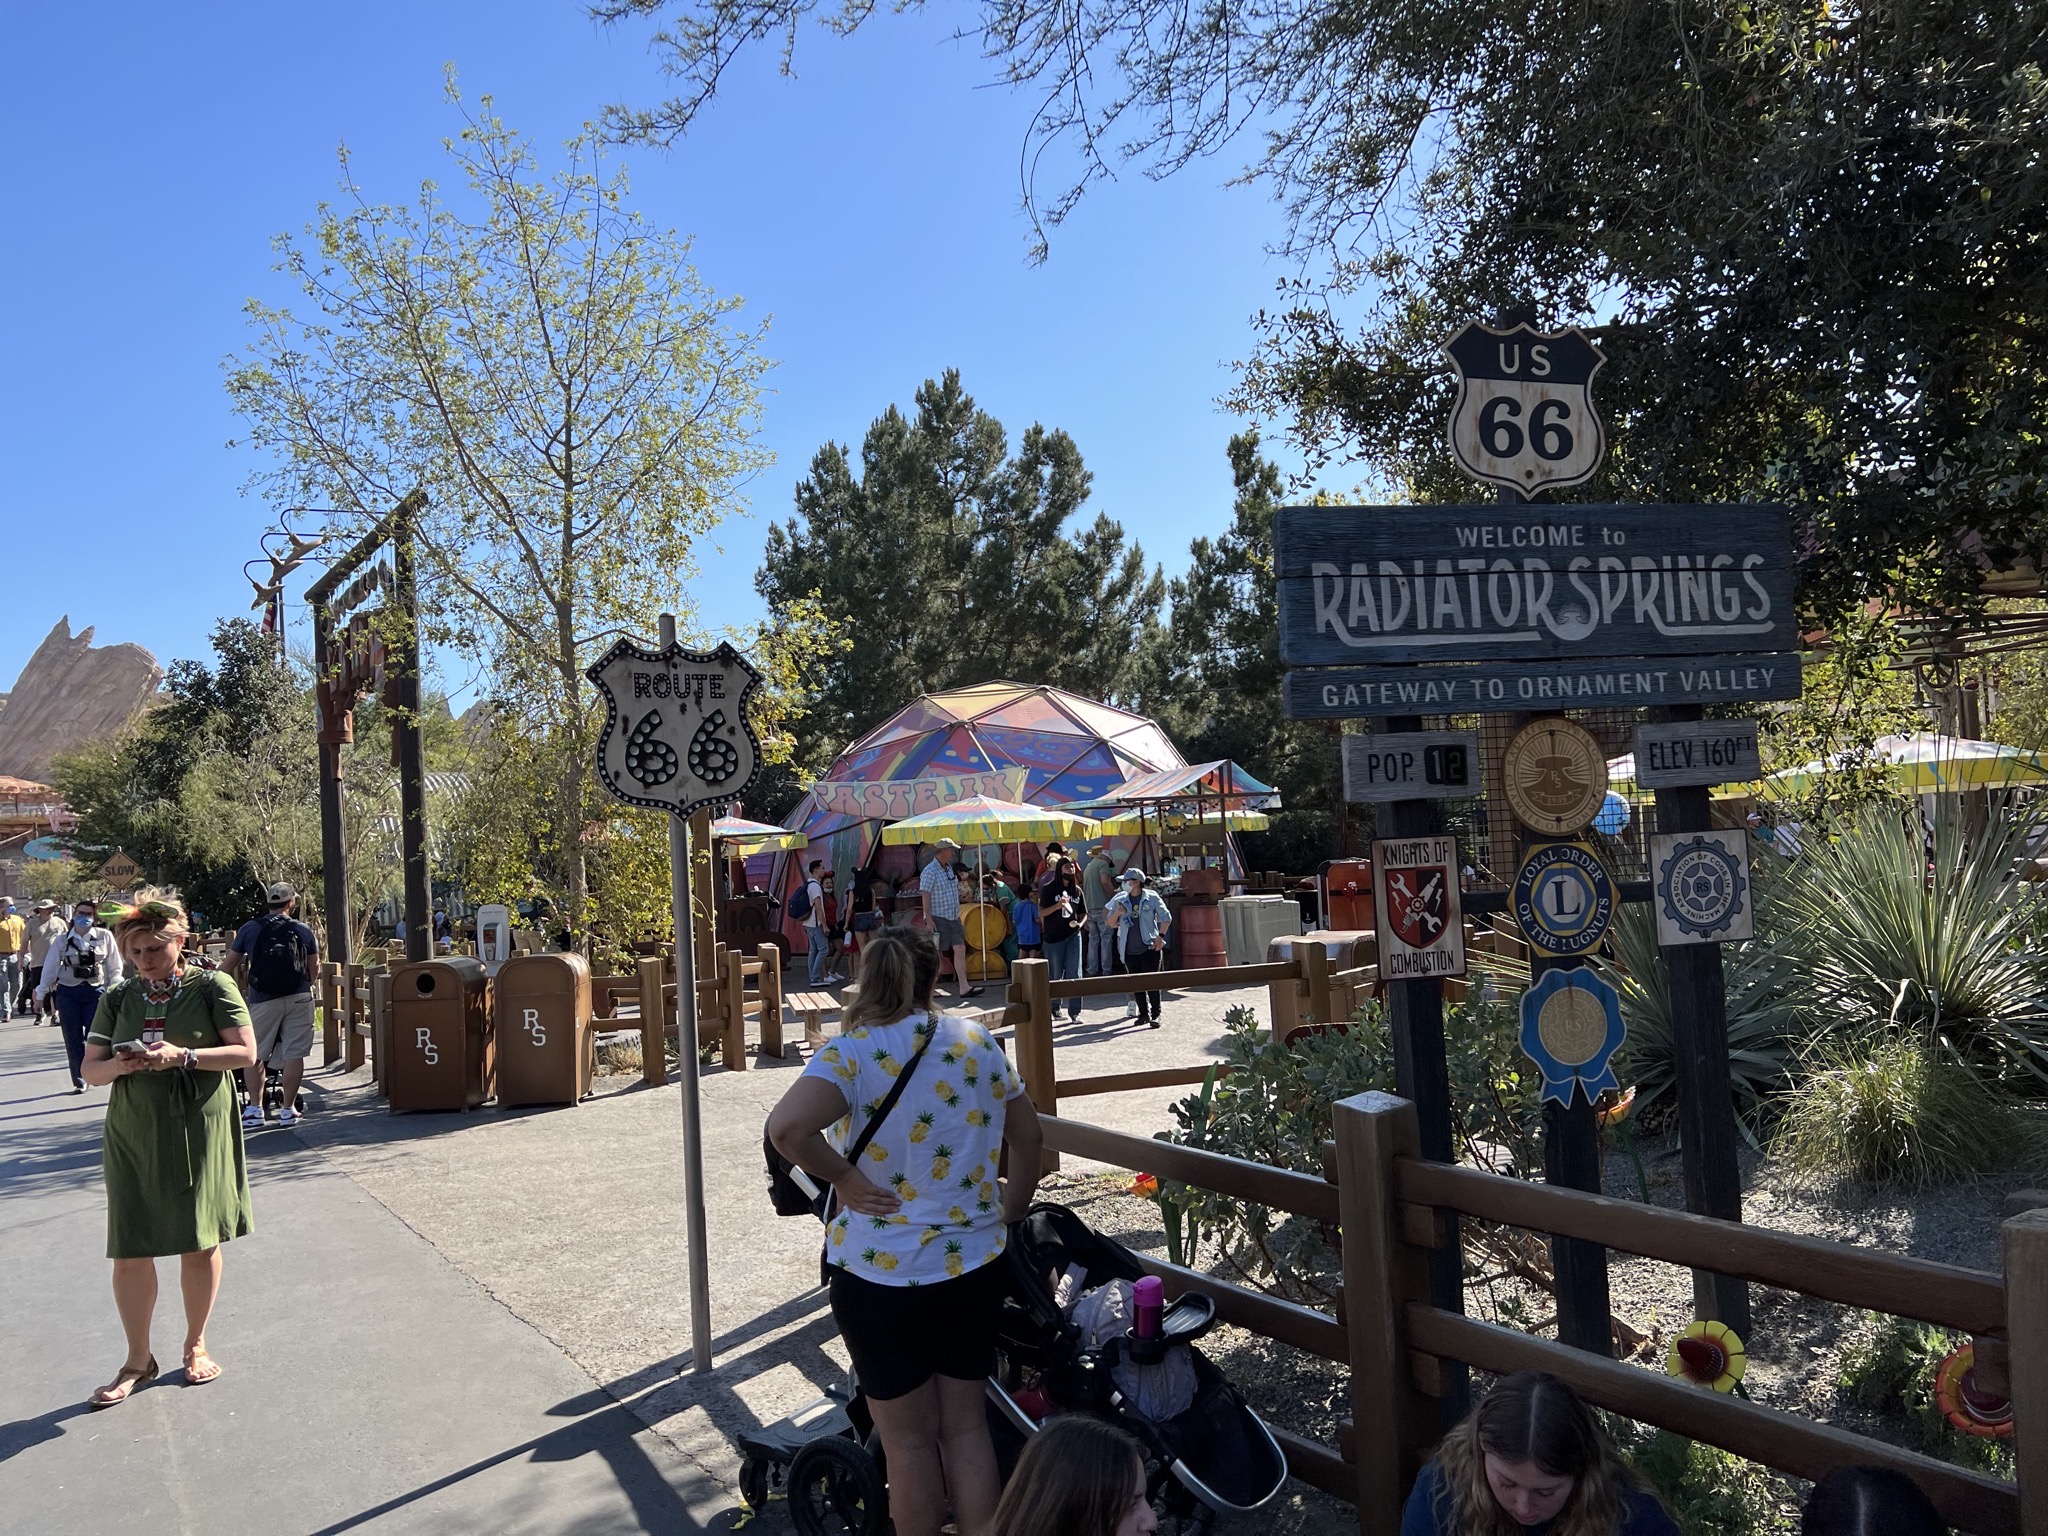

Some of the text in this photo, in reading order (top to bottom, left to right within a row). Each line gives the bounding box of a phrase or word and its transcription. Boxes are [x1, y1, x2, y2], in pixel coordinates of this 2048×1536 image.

[1499, 343, 1551, 376] US
[1478, 395, 1574, 461] 66
[1455, 525, 1626, 548] WELCOME to
[1311, 553, 1776, 647] RADIATOR SPRINGS
[633, 672, 725, 699] ROUTE
[1322, 667, 1775, 707] GATEWAY TO ORNAMENT VALLEY
[625, 708, 739, 786] 66
[1649, 740, 1697, 771] ELEV.
[1367, 749, 1461, 783] POP. 12
[1382, 841, 1449, 866] KNIGHTS OF
[1520, 848, 1603, 887] LOYAL ORDER
[1710, 857, 1728, 876] COGS
[104, 864, 135, 877] SLOW
[1673, 855, 1695, 908] ASSOCIATION
[1724, 878, 1731, 888] IN
[1551, 880, 1581, 916] L
[1695, 881, 1710, 893] RS
[1721, 892, 1731, 909] THE
[1519, 903, 1534, 922] OF
[1530, 924, 1558, 949] THE
[1685, 908, 1720, 920] MACHINE
[1390, 950, 1455, 974] COMBUSTION
